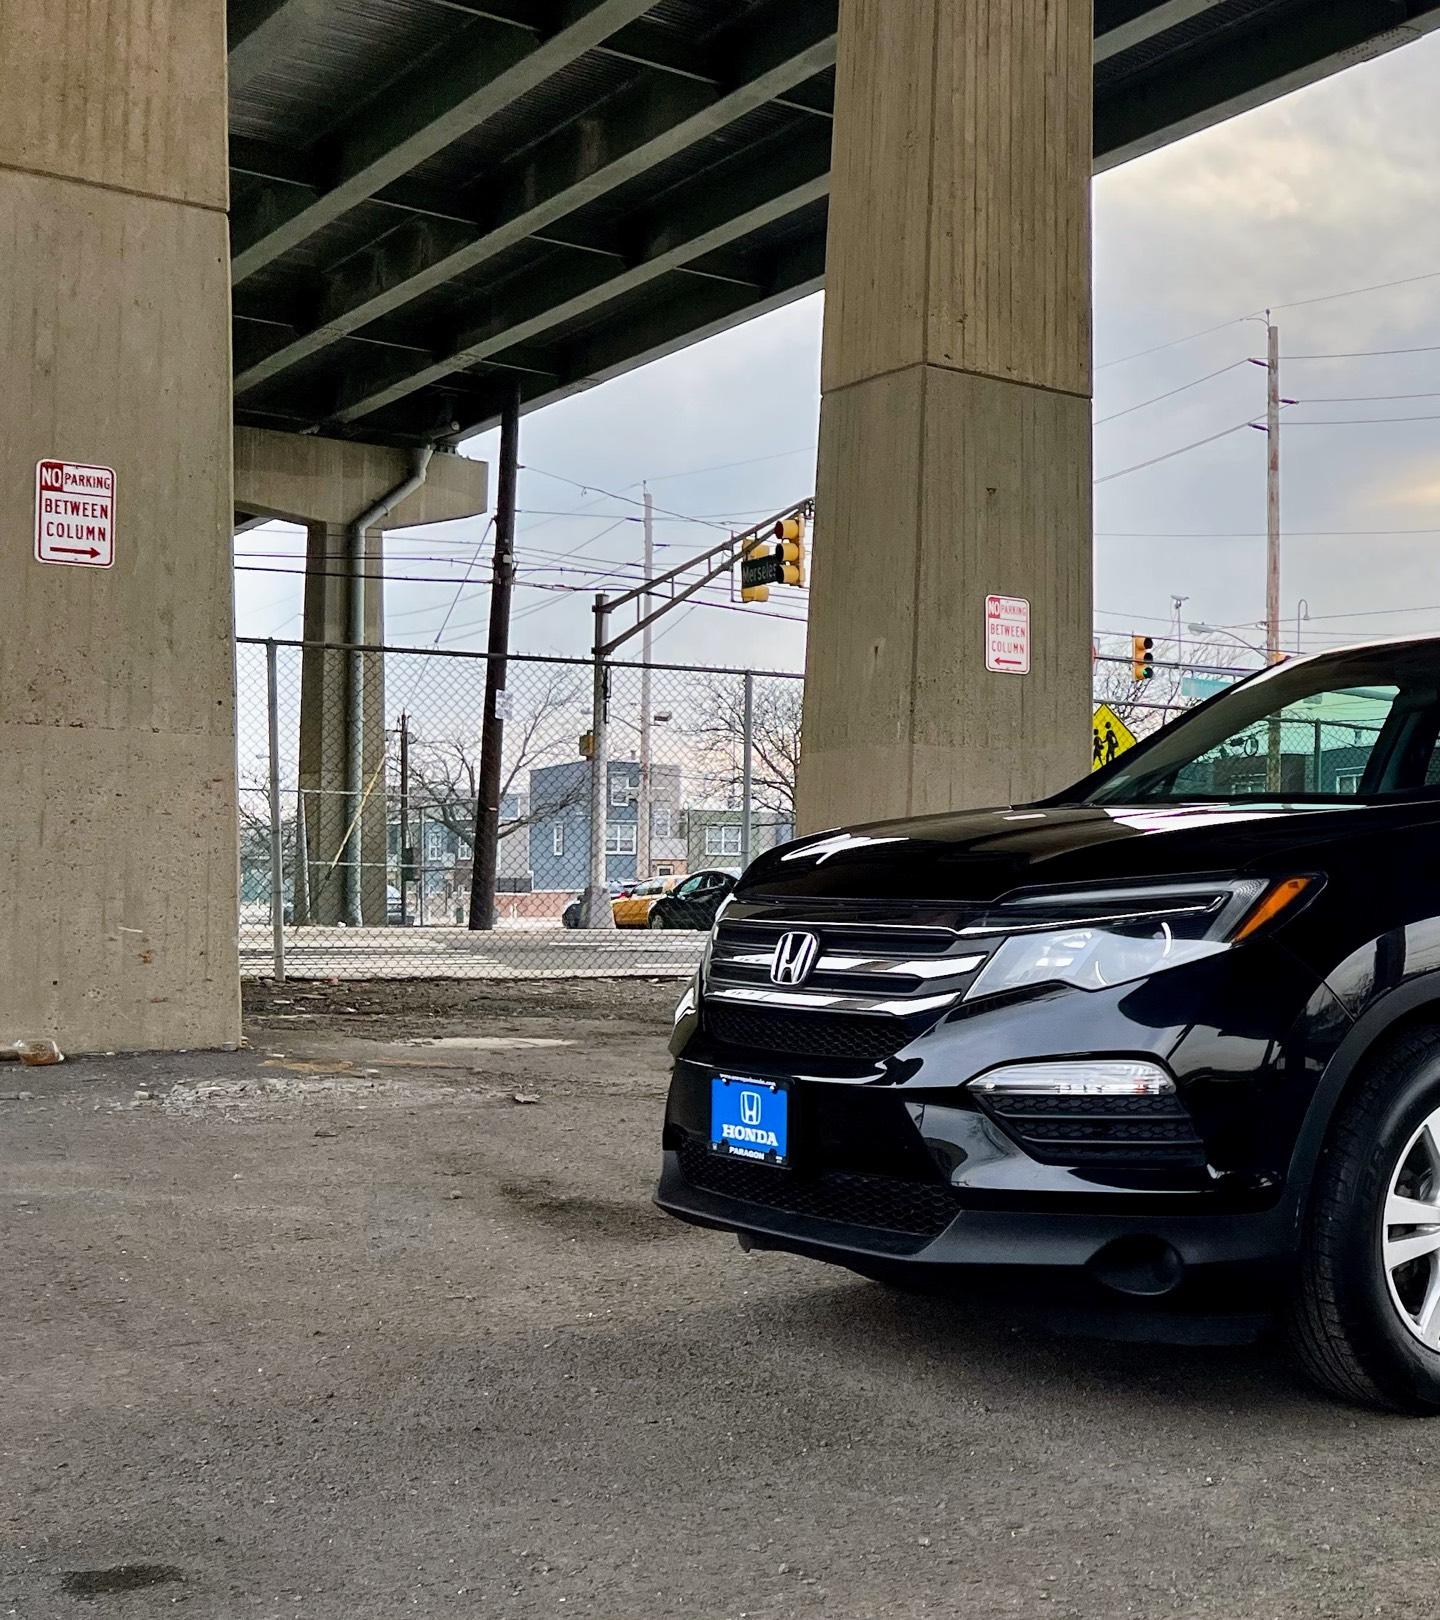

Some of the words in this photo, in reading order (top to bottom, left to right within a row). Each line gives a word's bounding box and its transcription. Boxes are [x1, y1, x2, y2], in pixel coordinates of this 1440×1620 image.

[41, 466, 62, 488] NO
[64, 472, 111, 490] PARKING
[44, 498, 108, 520] BETWEEN
[46, 521, 106, 542] COLUMN
[989, 600, 1000, 616] NO
[1001, 605, 1026, 616] PARKING
[990, 623, 1026, 638] BETWEEN
[991, 640, 1025, 654] COLUMN
[722, 1124, 779, 1147] HONDA
[728, 1146, 765, 1160] PARAGON
